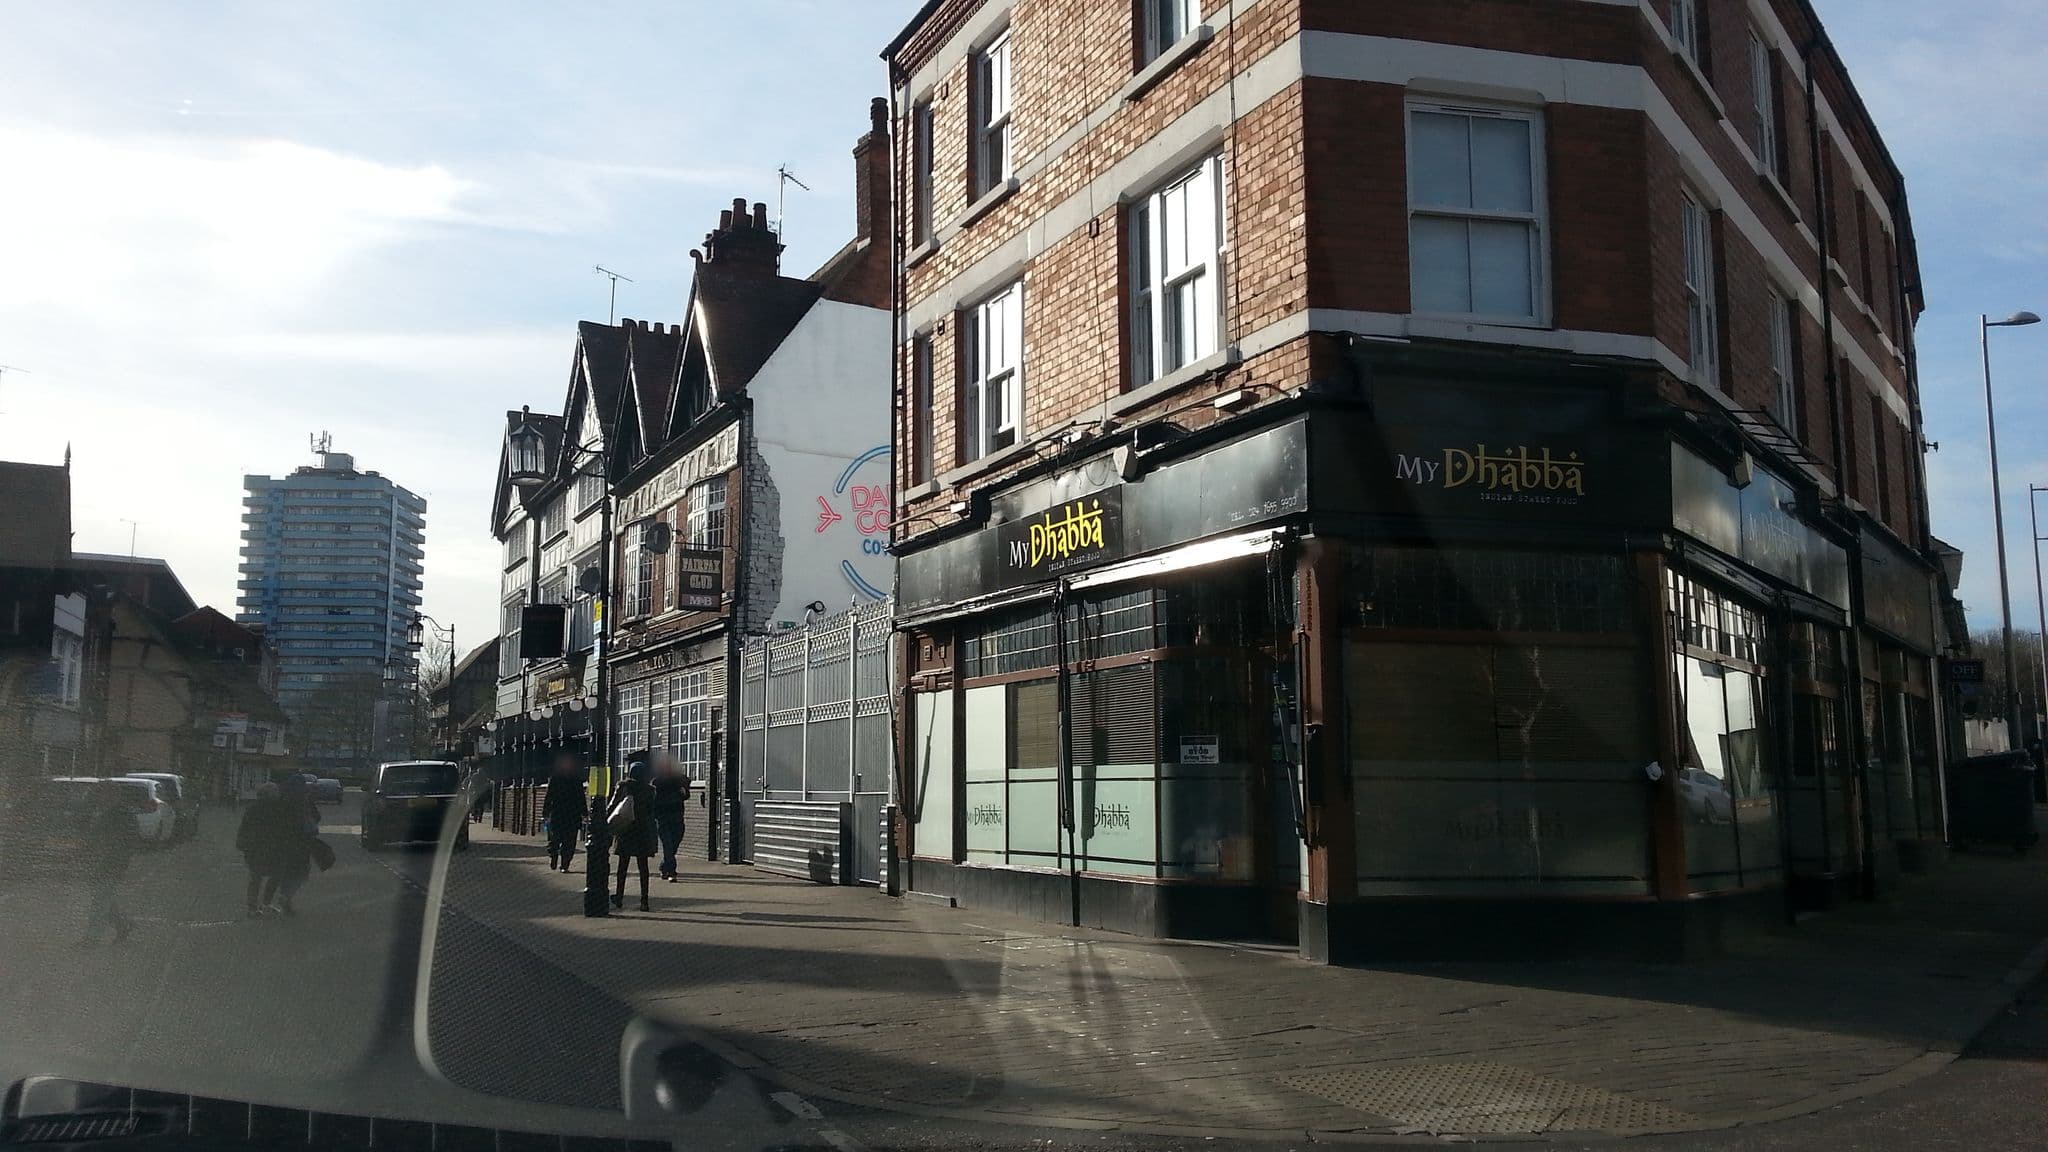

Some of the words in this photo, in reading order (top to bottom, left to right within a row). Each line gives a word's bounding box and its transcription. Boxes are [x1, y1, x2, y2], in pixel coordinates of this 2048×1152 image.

[1443, 444, 1584, 496] Dhabba
[1029, 498, 1105, 568] Dhabba
[681, 557, 721, 574] FAIRFAX
[689, 574, 713, 590] CLUB
